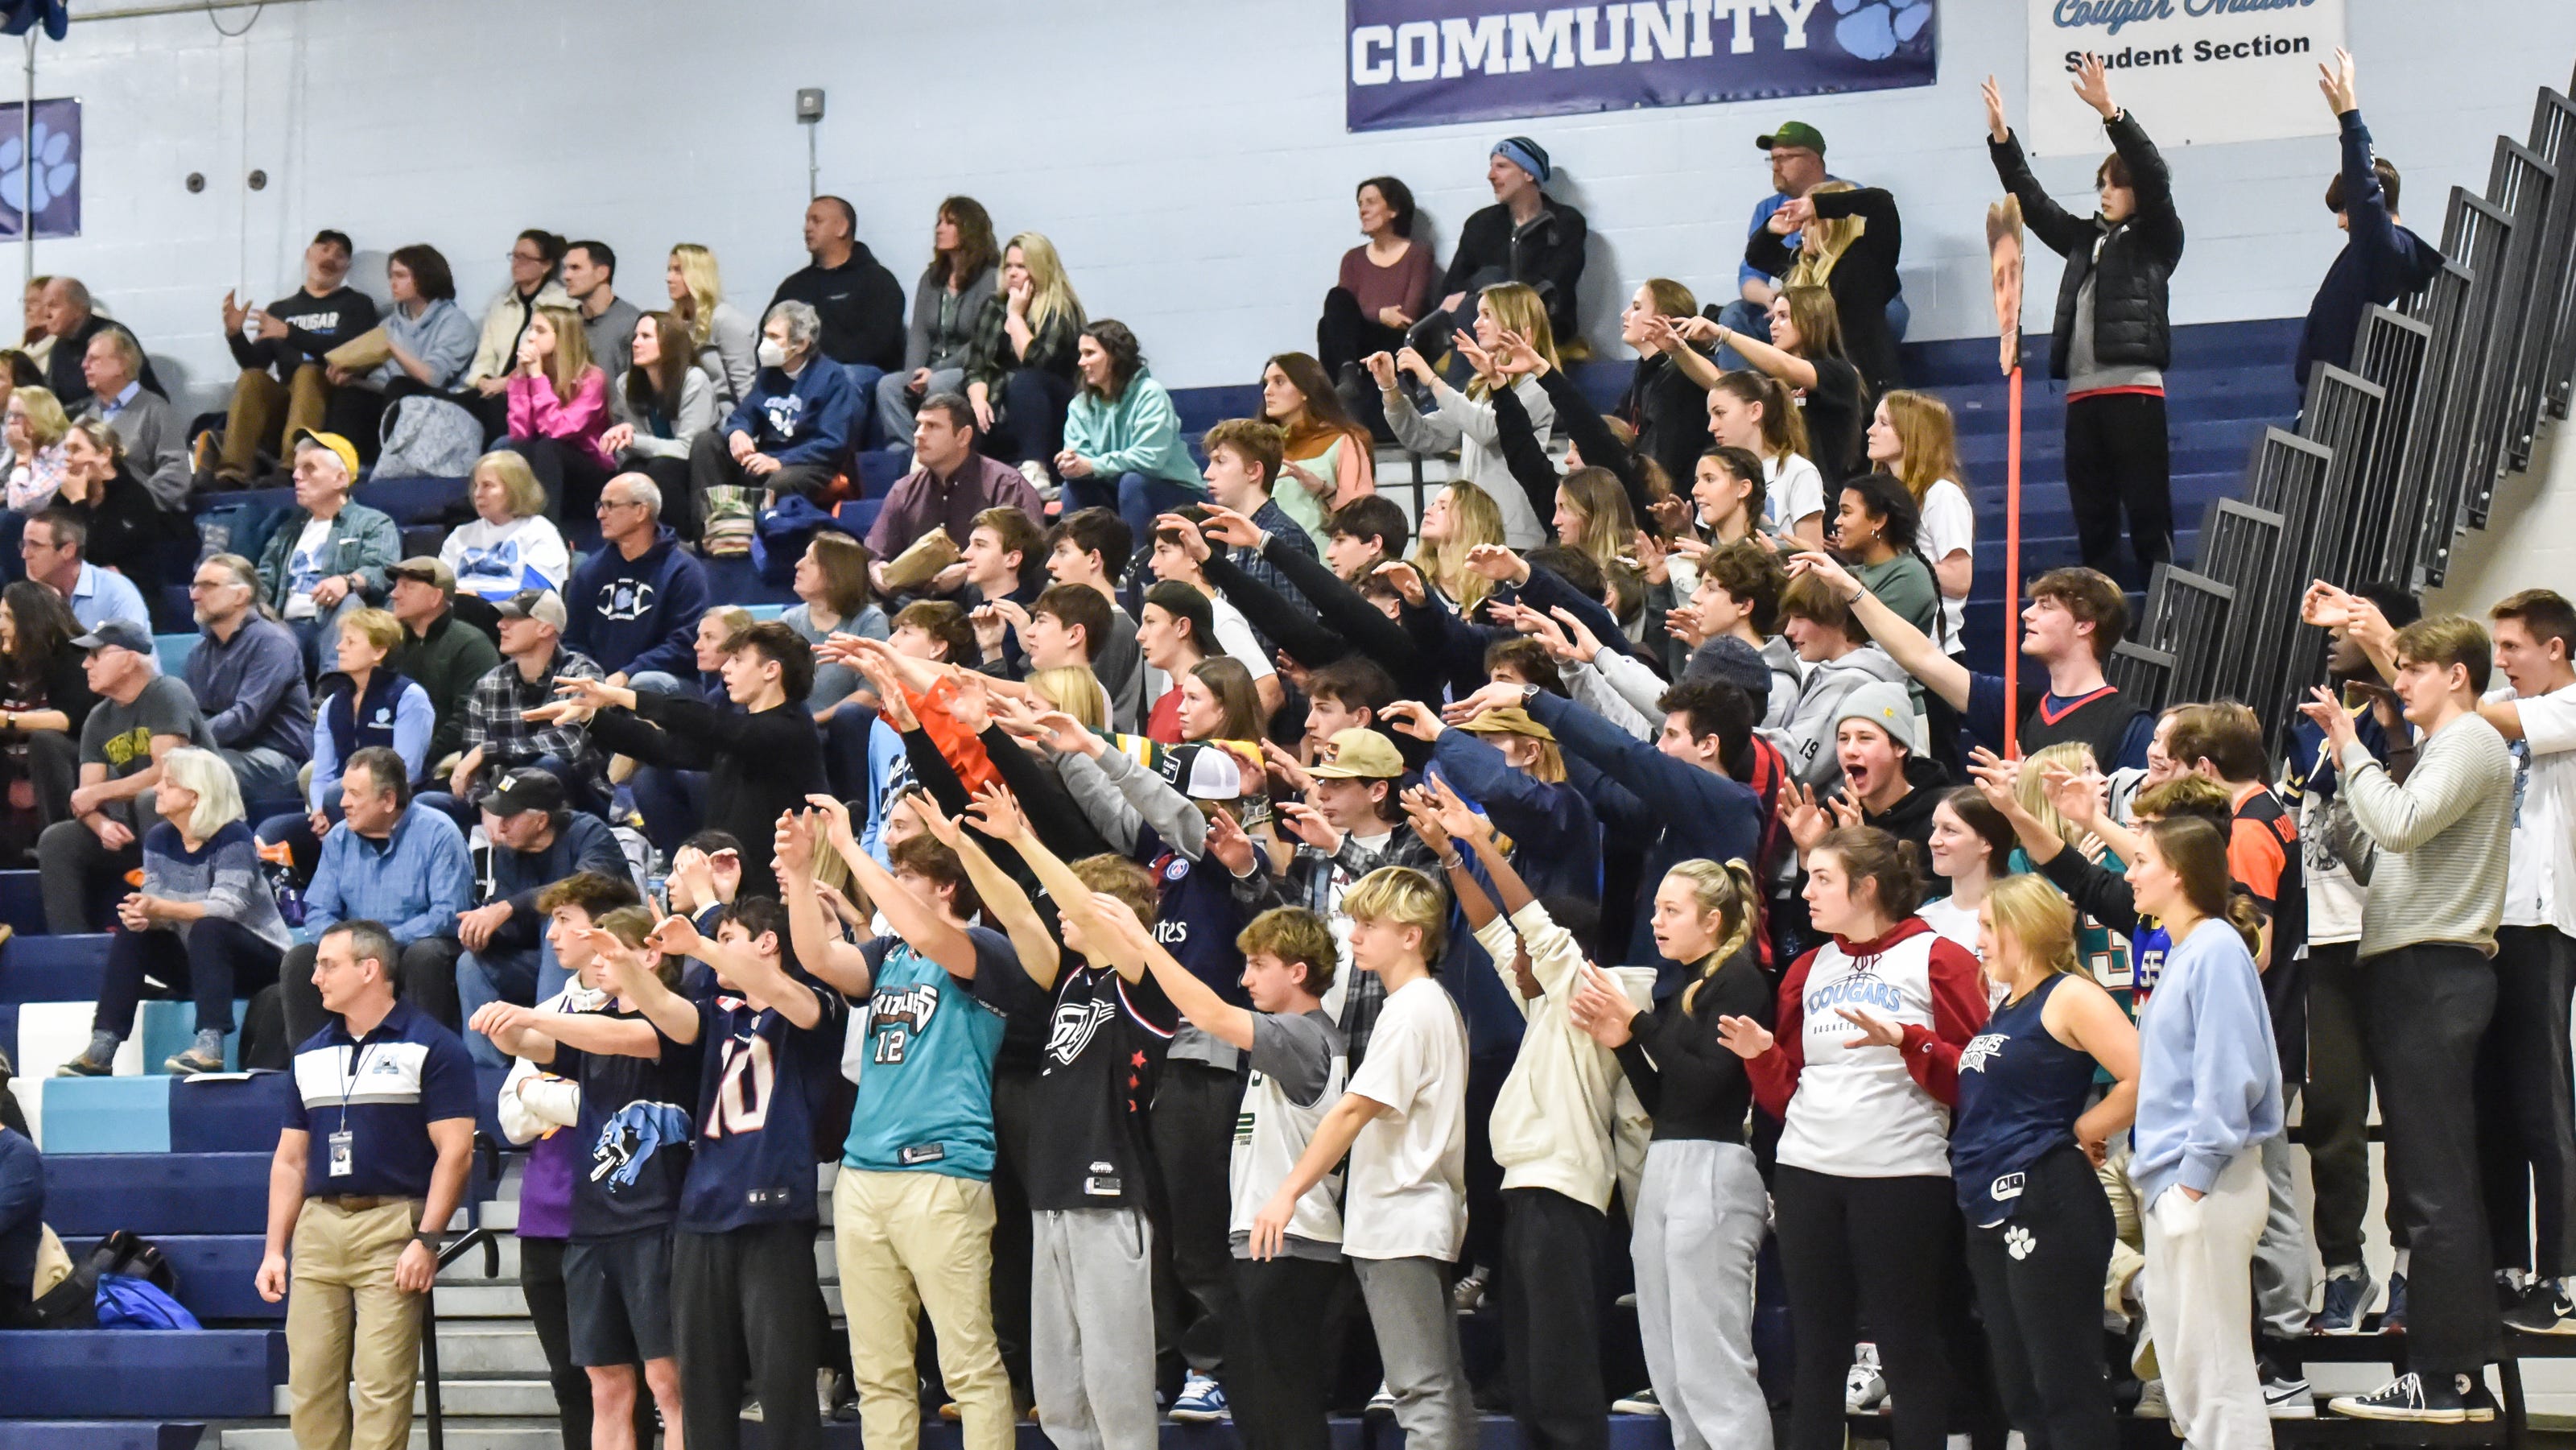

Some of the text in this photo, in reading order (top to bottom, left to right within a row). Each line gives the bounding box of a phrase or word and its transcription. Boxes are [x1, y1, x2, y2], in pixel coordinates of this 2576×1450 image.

[1352, 0, 1821, 86] COMMUNITY
[2065, 35, 2310, 73] Sudent Section
[1798, 737, 1819, 761] 19
[1151, 919, 1187, 944] tes
[2140, 950, 2164, 987] 55
[1808, 981, 1901, 1015] COUGARS
[874, 1030, 906, 1064] 12
[704, 1034, 775, 1138] 10
